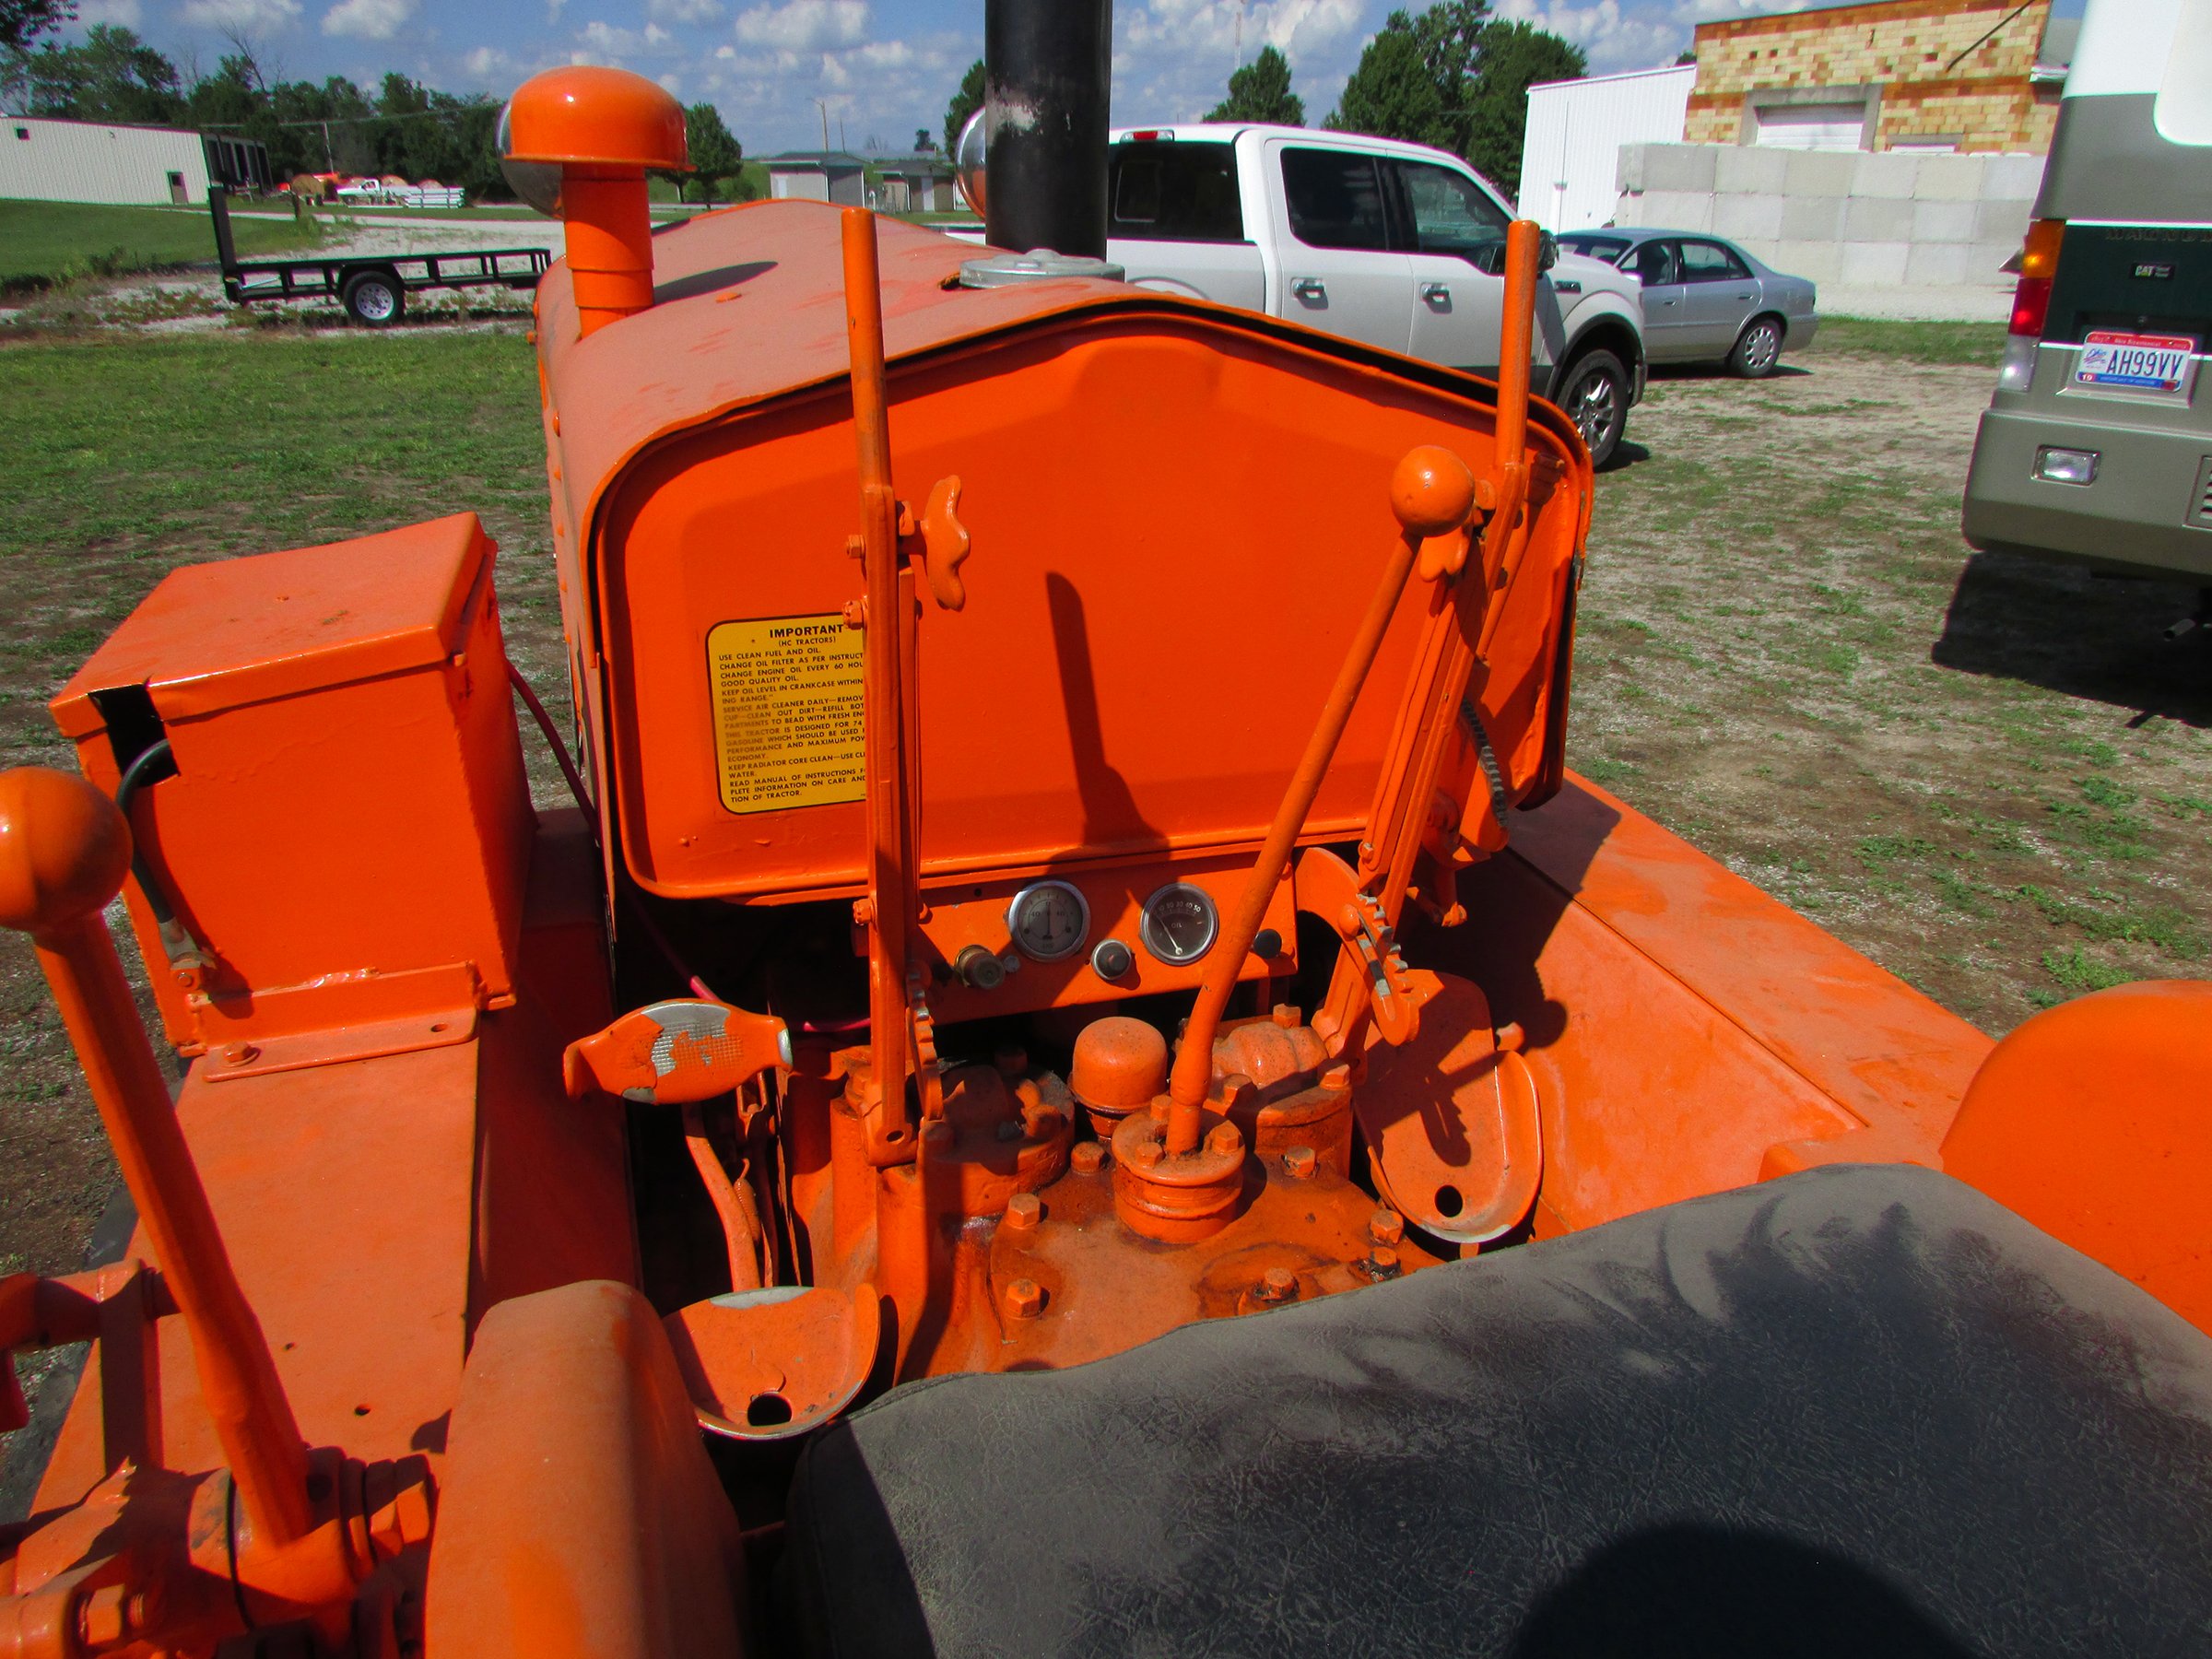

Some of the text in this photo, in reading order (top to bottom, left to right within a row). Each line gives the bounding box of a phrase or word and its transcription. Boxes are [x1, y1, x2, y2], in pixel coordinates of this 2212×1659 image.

[2136, 265, 2154, 277] CAT
[2106, 349, 2183, 379] AH99VV
[770, 624, 843, 638] IMPORTANT
[796, 637, 836, 645] TRACTORS)
[720, 662, 751, 670] CHANGE
[722, 679, 745, 688] GOOD
[748, 677, 781, 685] QUALITY
[790, 681, 835, 689] CRANKCASE
[724, 705, 752, 713] SERVICE
[772, 700, 804, 709] CLEANER
[795, 724, 830, 732] DESIGNED
[808, 737, 846, 747] MAXIMUM
[748, 759, 786, 769] RADIATOR
[806, 769, 855, 779] INSTRUCTIONS
[755, 782, 807, 792] INFORMATION
